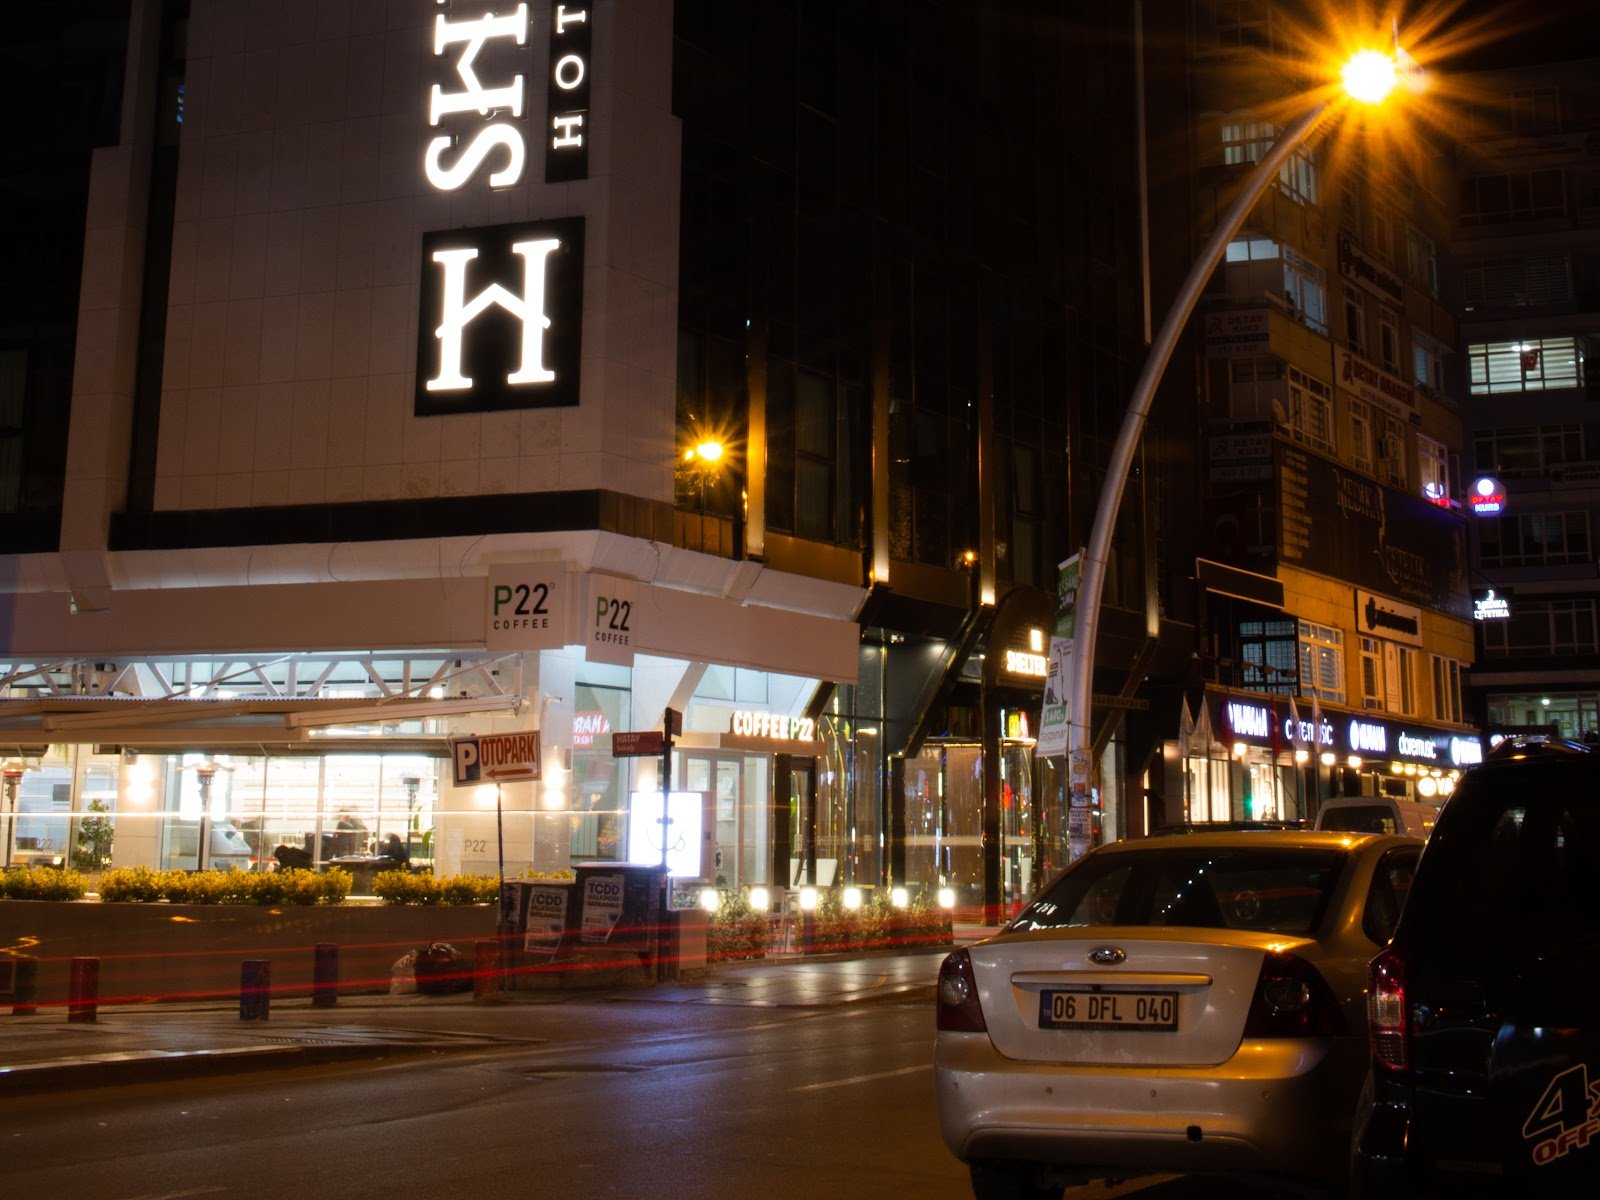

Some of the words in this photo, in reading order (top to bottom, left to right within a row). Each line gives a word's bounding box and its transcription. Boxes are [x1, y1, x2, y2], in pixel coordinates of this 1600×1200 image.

[1472, 495, 1503, 504] DETAY
[494, 583, 549, 616] P22
[596, 596, 631, 632] P22
[494, 619, 549, 630] COFFEE
[595, 631, 630, 646] COFFEE
[733, 710, 789, 739] COFFEE
[790, 716, 814, 742] P22
[616, 734, 640, 744] HATAY
[458, 742, 478, 781] P
[481, 735, 536, 767] OTOPARK
[465, 840, 487, 853] P22
[589, 883, 620, 894] TCDD
[1053, 995, 1076, 1019] 06
[1088, 996, 1122, 1021] DFL
[1136, 997, 1172, 1022] 040
